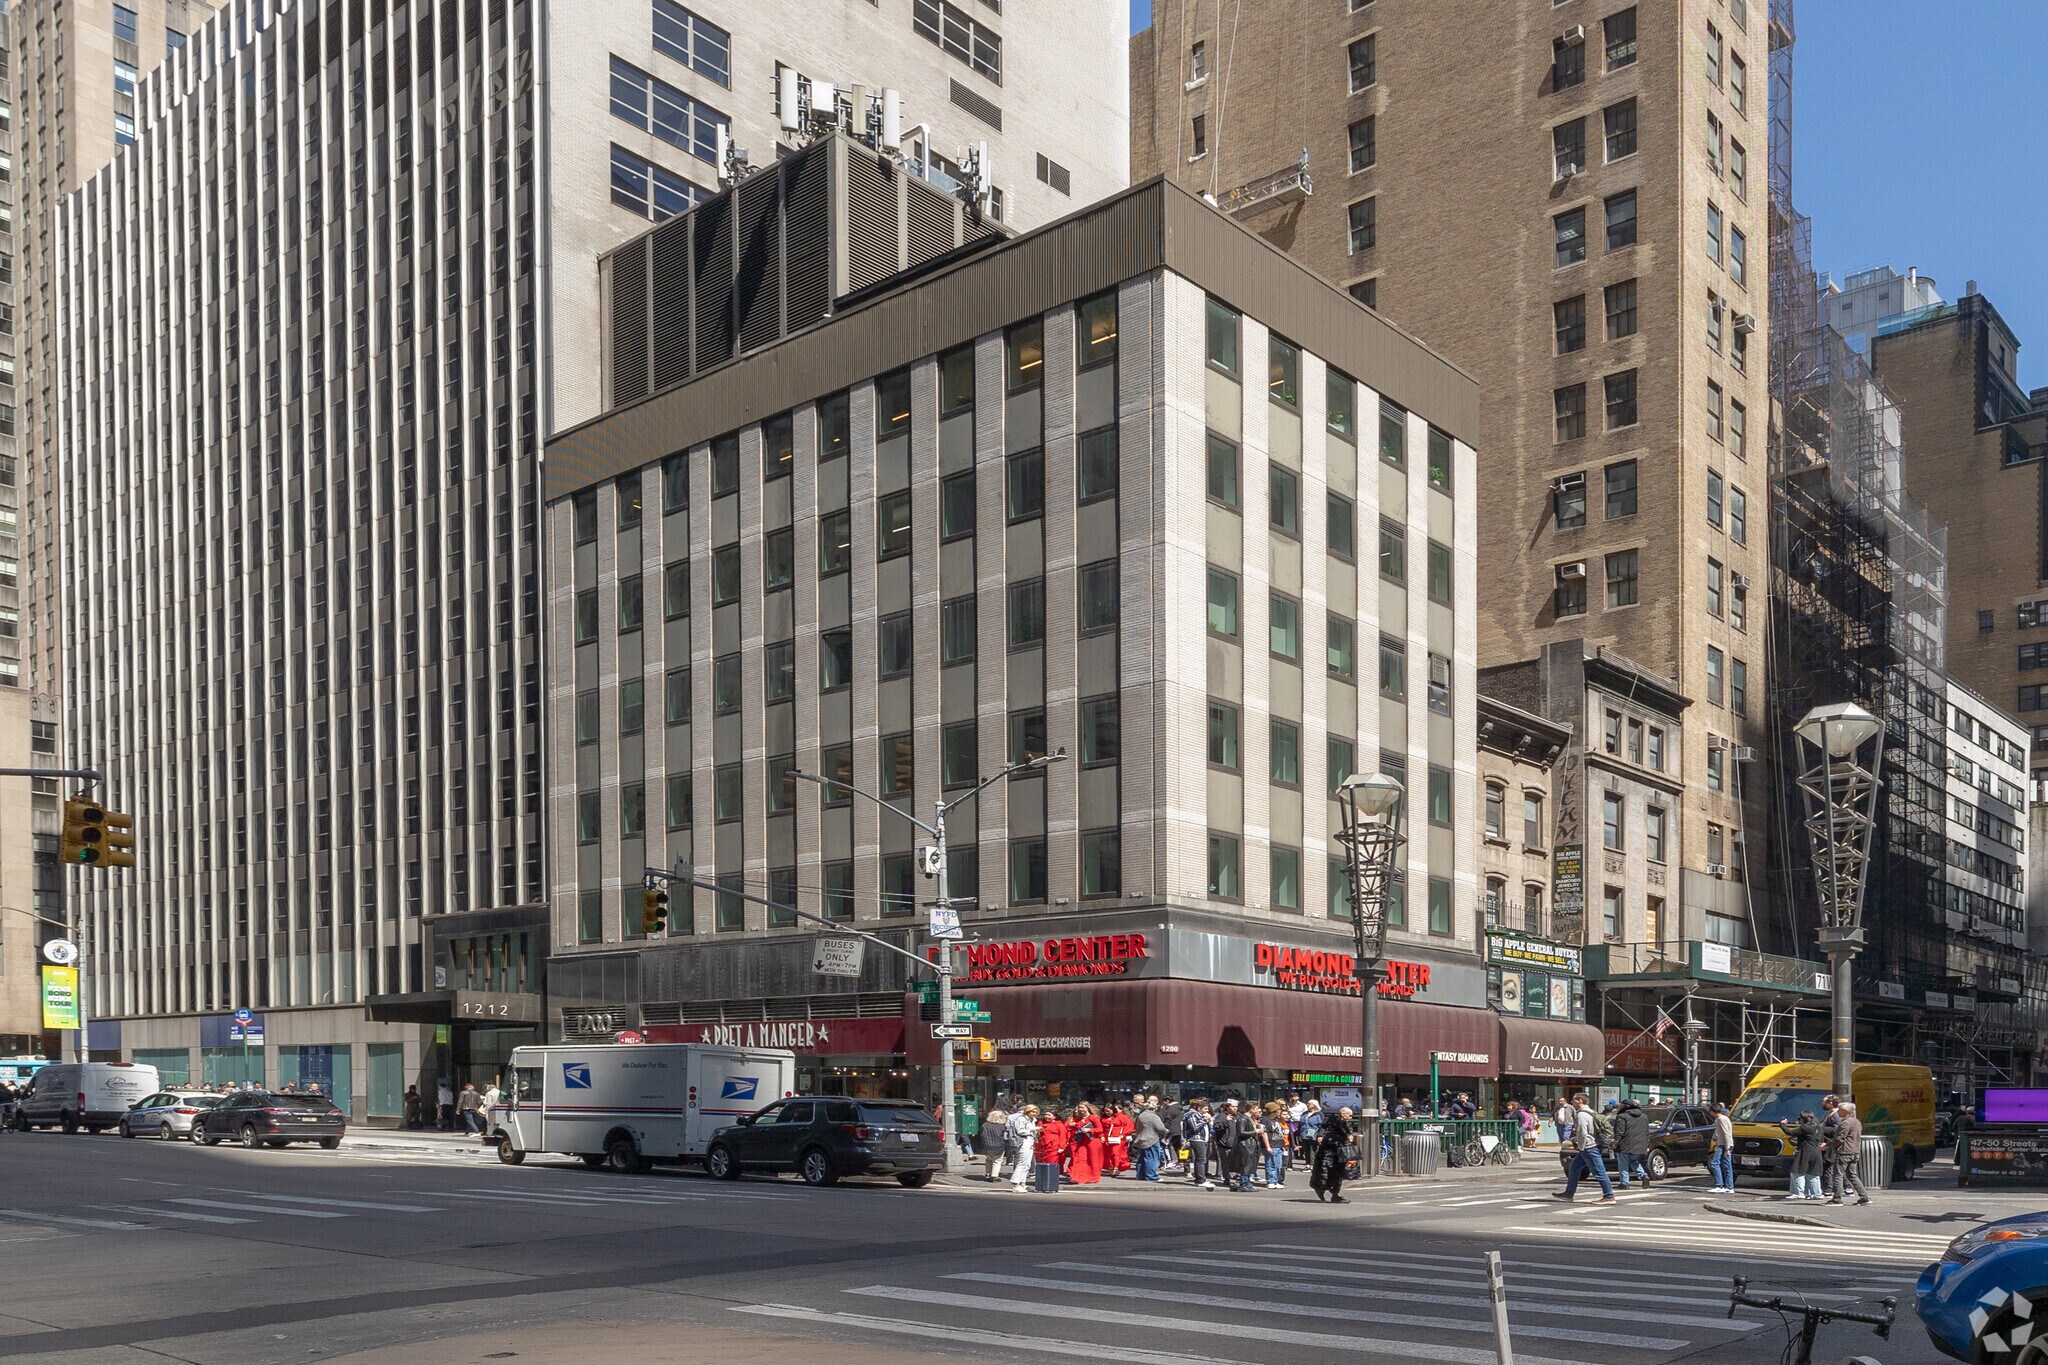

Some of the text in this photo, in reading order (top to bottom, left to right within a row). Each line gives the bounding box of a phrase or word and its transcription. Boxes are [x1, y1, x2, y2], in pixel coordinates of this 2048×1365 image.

[935, 910, 957, 918] NYPD
[824, 940, 855, 950] BUSES
[1043, 934, 1147, 963] CENTER
[1504, 939, 1526, 951] APPLE
[1526, 942, 1554, 955] GENERAL
[1554, 947, 1578, 959] BUYERS
[825, 953, 850, 961] ONLY
[1255, 943, 1431, 985] DIAMOND NTER
[970, 961, 1125, 981] BUY GOLD & DIAMONDS
[1279, 972, 1296, 984] WE
[1300, 973, 1321, 986] BUY
[1322, 976, 1351, 990] GOLD
[463, 1003, 508, 1016] 1212
[964, 1001, 971, 1010] 47
[713, 1022, 815, 1047] PRET A MANGER
[1605, 1033, 1626, 1047] TAIL
[1627, 1034, 1645, 1048] FOR
[996, 1036, 1091, 1049] JEWELRY EXCHANGE
[1304, 1043, 1341, 1056] MALIDANI
[1530, 1042, 1583, 1062] ZOLAND
[1437, 1051, 1489, 1064] NTASY DIAMONDS
[1423, 1123, 1445, 1133] Subway
[1970, 1139, 2037, 1147] 47-50 Streets
